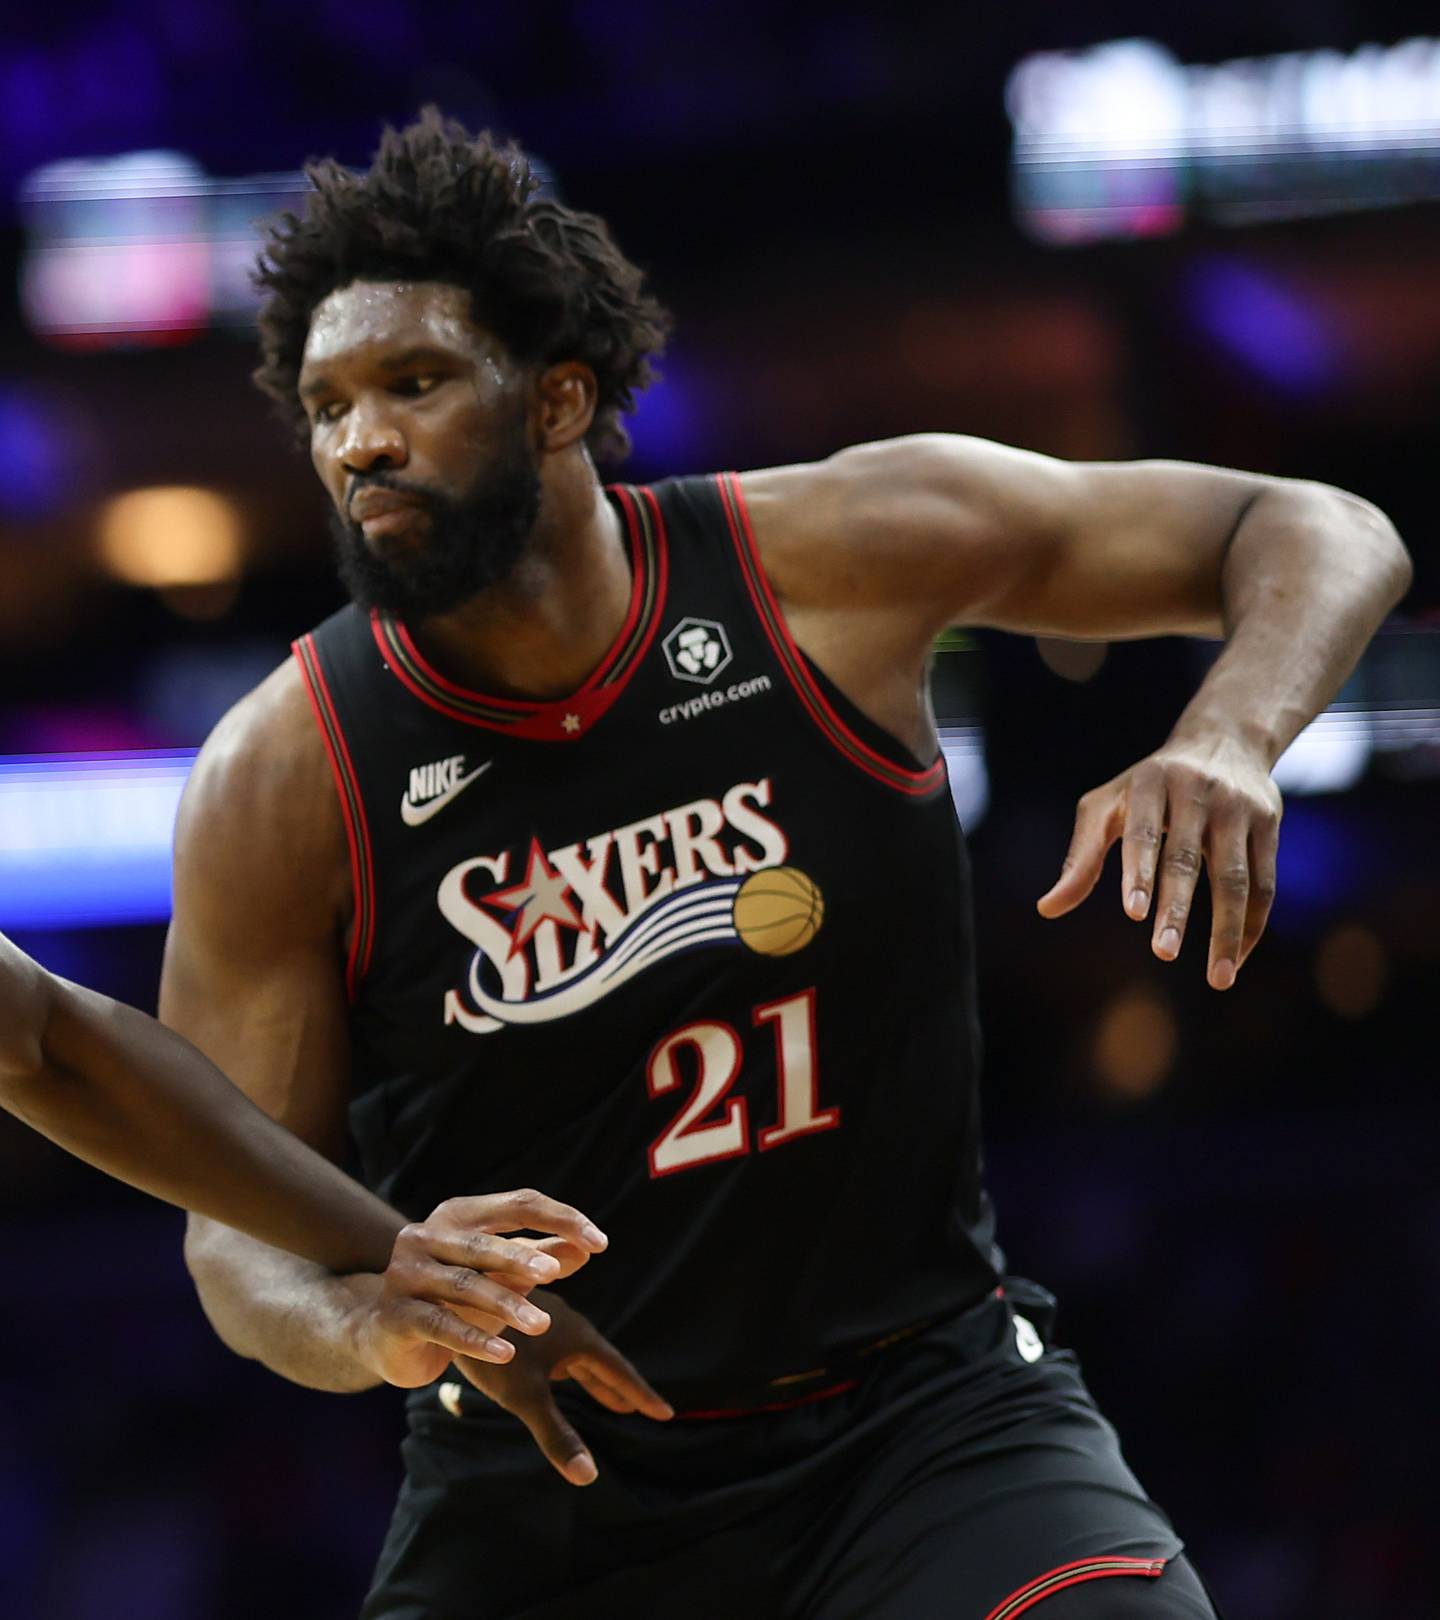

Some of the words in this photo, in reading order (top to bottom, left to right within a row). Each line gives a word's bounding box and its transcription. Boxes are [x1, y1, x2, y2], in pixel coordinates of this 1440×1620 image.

[658, 675, 772, 725] crypto.com
[409, 754, 466, 804] NIKE
[646, 986, 841, 1179] 21
